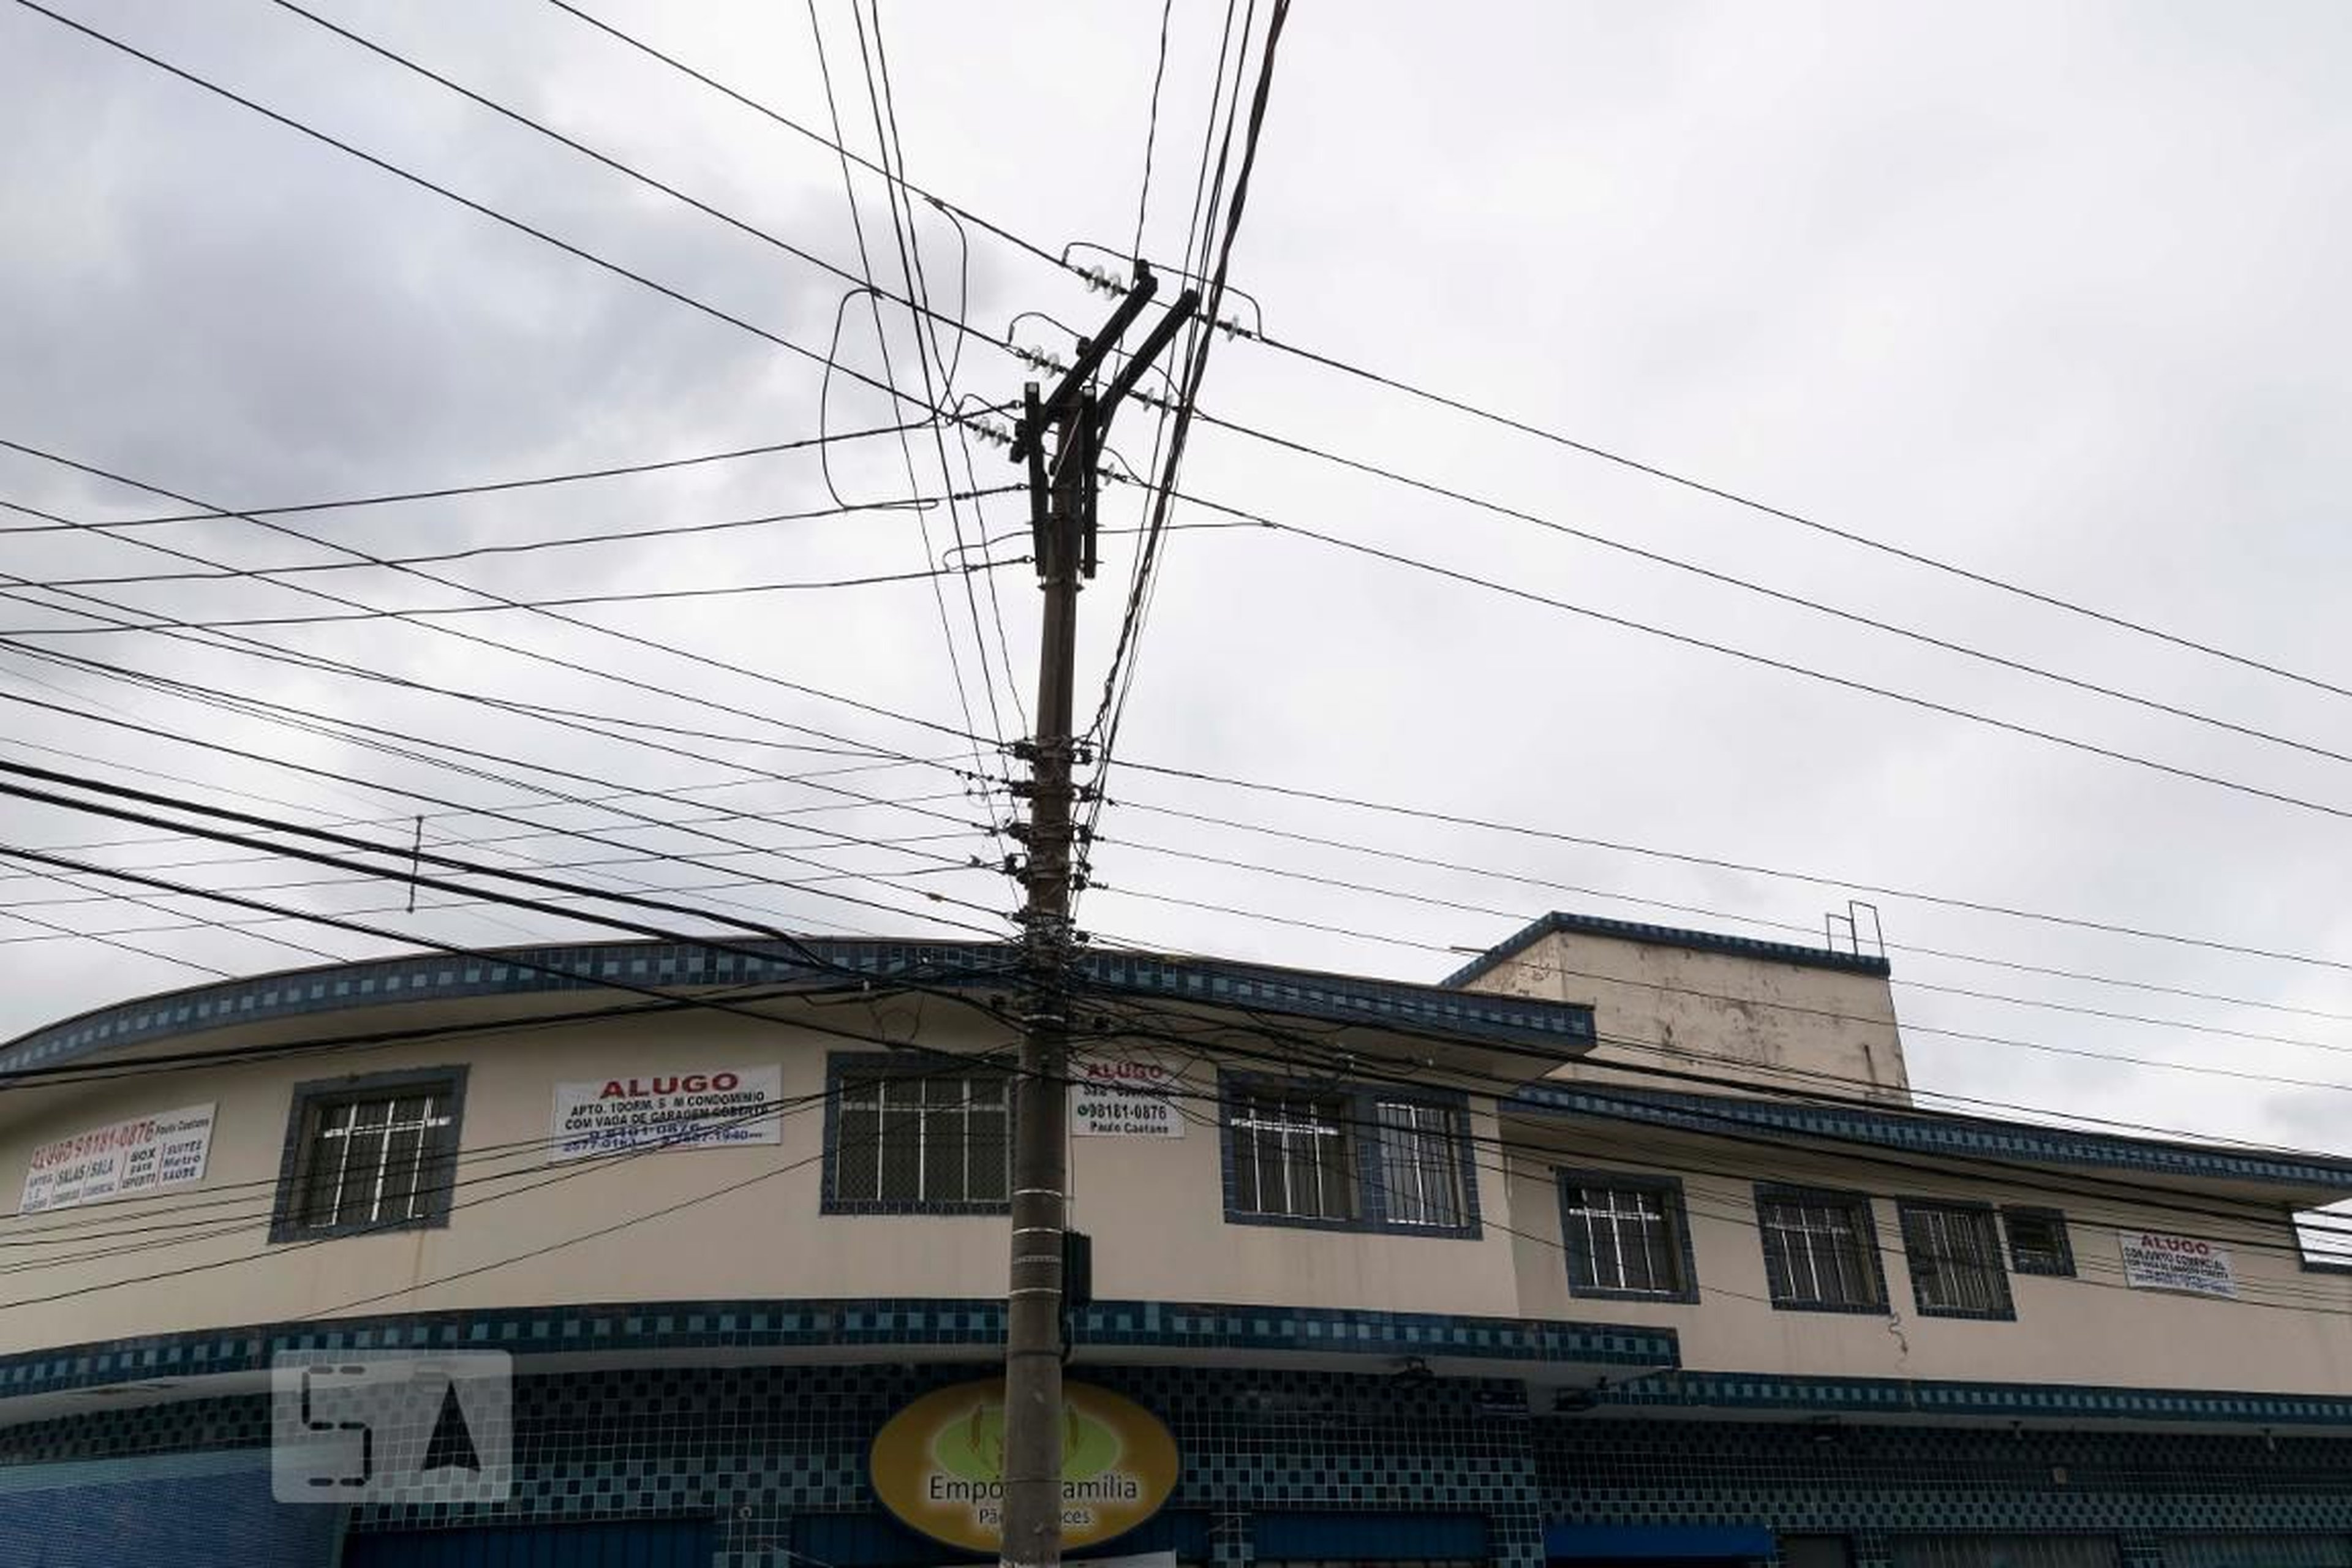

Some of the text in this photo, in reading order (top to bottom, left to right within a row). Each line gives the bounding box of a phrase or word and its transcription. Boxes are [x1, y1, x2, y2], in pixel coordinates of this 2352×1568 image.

[1088, 1063, 1164, 1079] ALUGO
[600, 1072, 739, 1099] ALUGO
[631, 1113, 647, 1125] DE
[2141, 1234, 2209, 1256] ALUGO
[1062, 1475, 1137, 1499] amília
